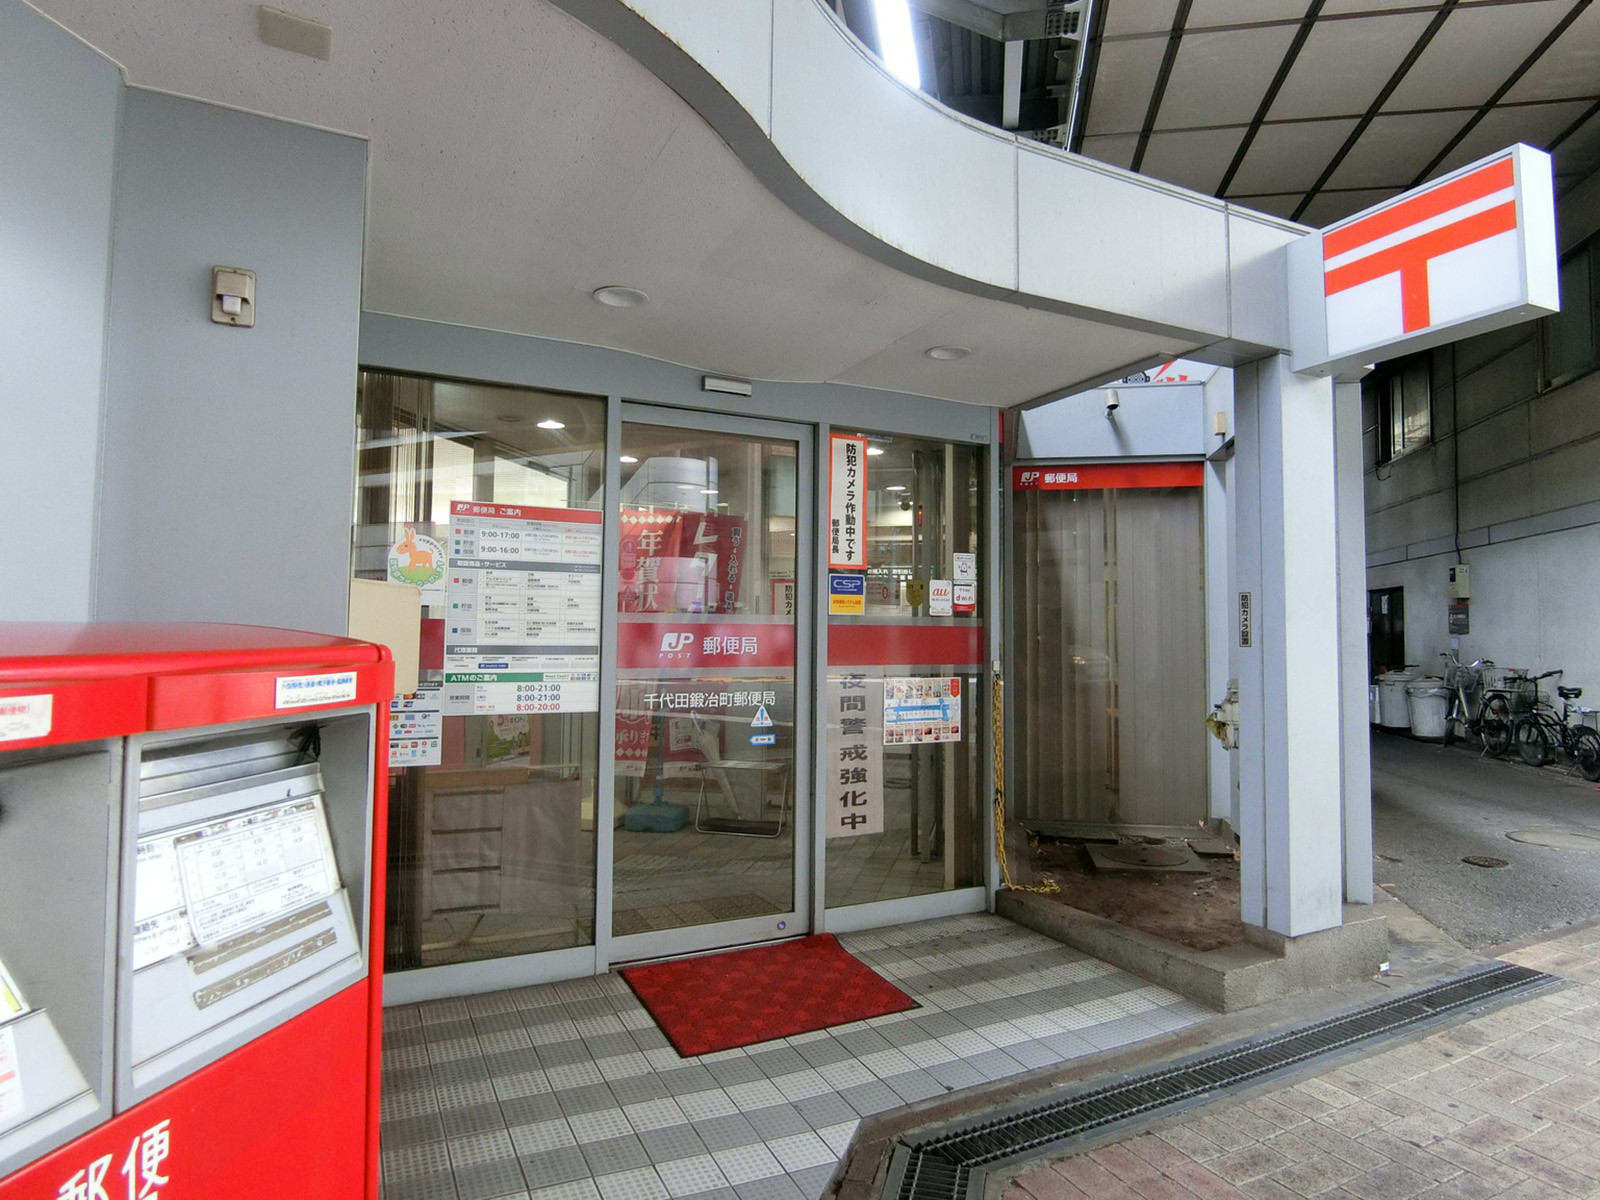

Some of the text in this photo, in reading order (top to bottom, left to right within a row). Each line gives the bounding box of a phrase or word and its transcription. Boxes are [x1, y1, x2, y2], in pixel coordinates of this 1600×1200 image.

[1044, 472, 1078, 484] 郵便局
[845, 443, 857, 562] 防犯カメラ作動中です
[472, 506, 496, 515] 郵便局
[499, 507, 522, 517] ご案内
[481, 530, 520, 540] 9:00-17:00
[831, 518, 840, 554] 郵便局長
[480, 545, 520, 555] 9:00-16:00
[636, 528, 664, 612] 年賀状
[833, 579, 861, 588] CSP
[932, 587, 949, 597] au
[702, 636, 758, 656] 郵便局
[450, 674, 498, 682] ATMのご案内
[516, 684, 561, 692] 8:00-21:00
[516, 693, 561, 702] 8:00-21:00
[516, 703, 561, 712] 8:00-20:00
[839, 673, 868, 830] 夜間警戒強化中
